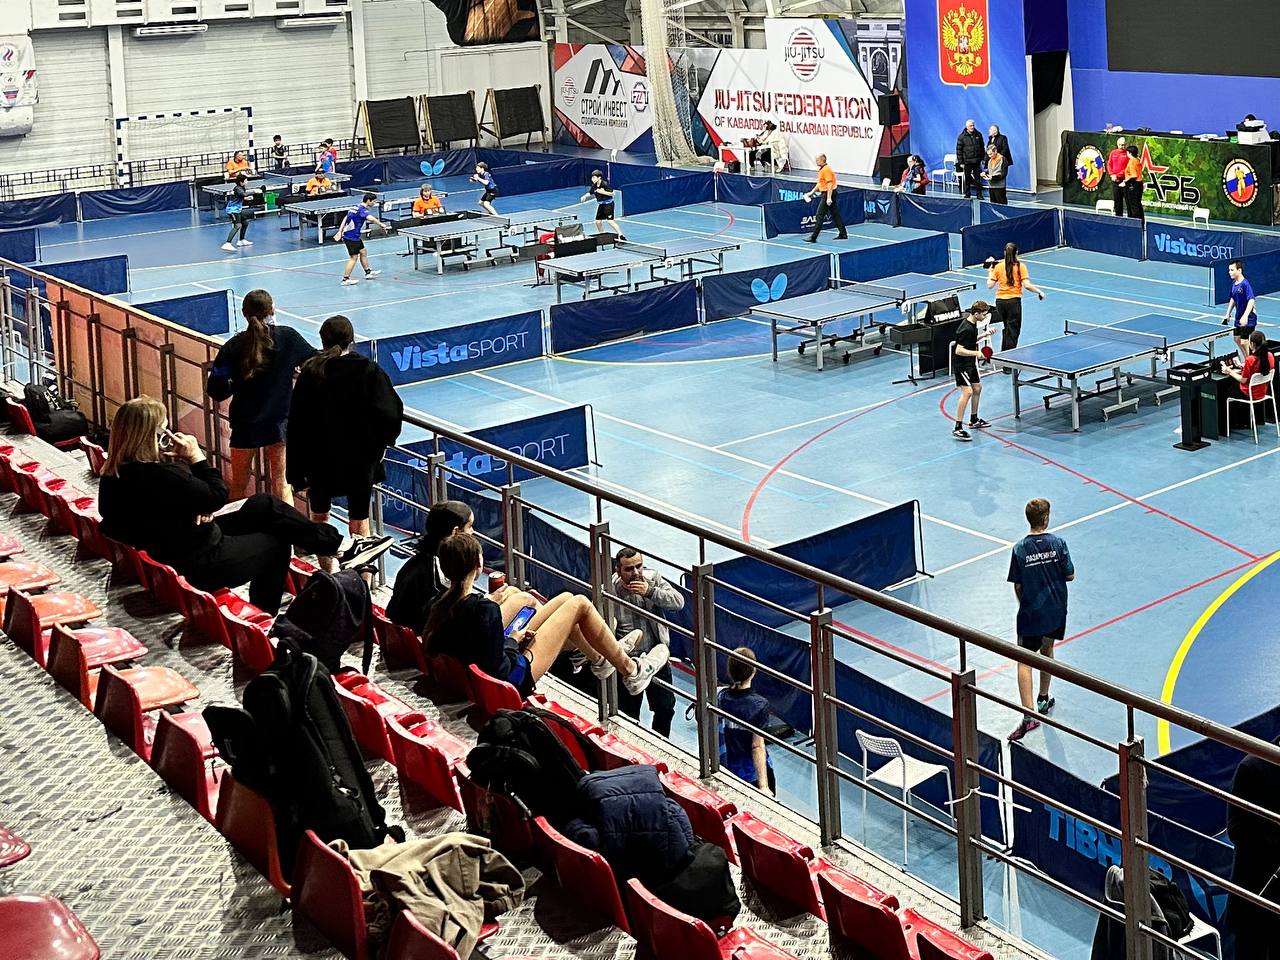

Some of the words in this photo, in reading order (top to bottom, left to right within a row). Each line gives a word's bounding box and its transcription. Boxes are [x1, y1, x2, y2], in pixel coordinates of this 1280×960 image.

[785, 46, 825, 62] JIU-JITSU
[581, 96, 601, 115] СТРОЙ
[604, 101, 627, 118] ИНВЕСТ
[715, 89, 771, 112] JIU-JITSU
[775, 93, 872, 120] FEDERATION
[715, 116, 725, 127] OF
[831, 125, 873, 139] REPUBLIC
[1154, 233, 1234, 259] VistaSPORT
[391, 330, 529, 372] VistaSPORT
